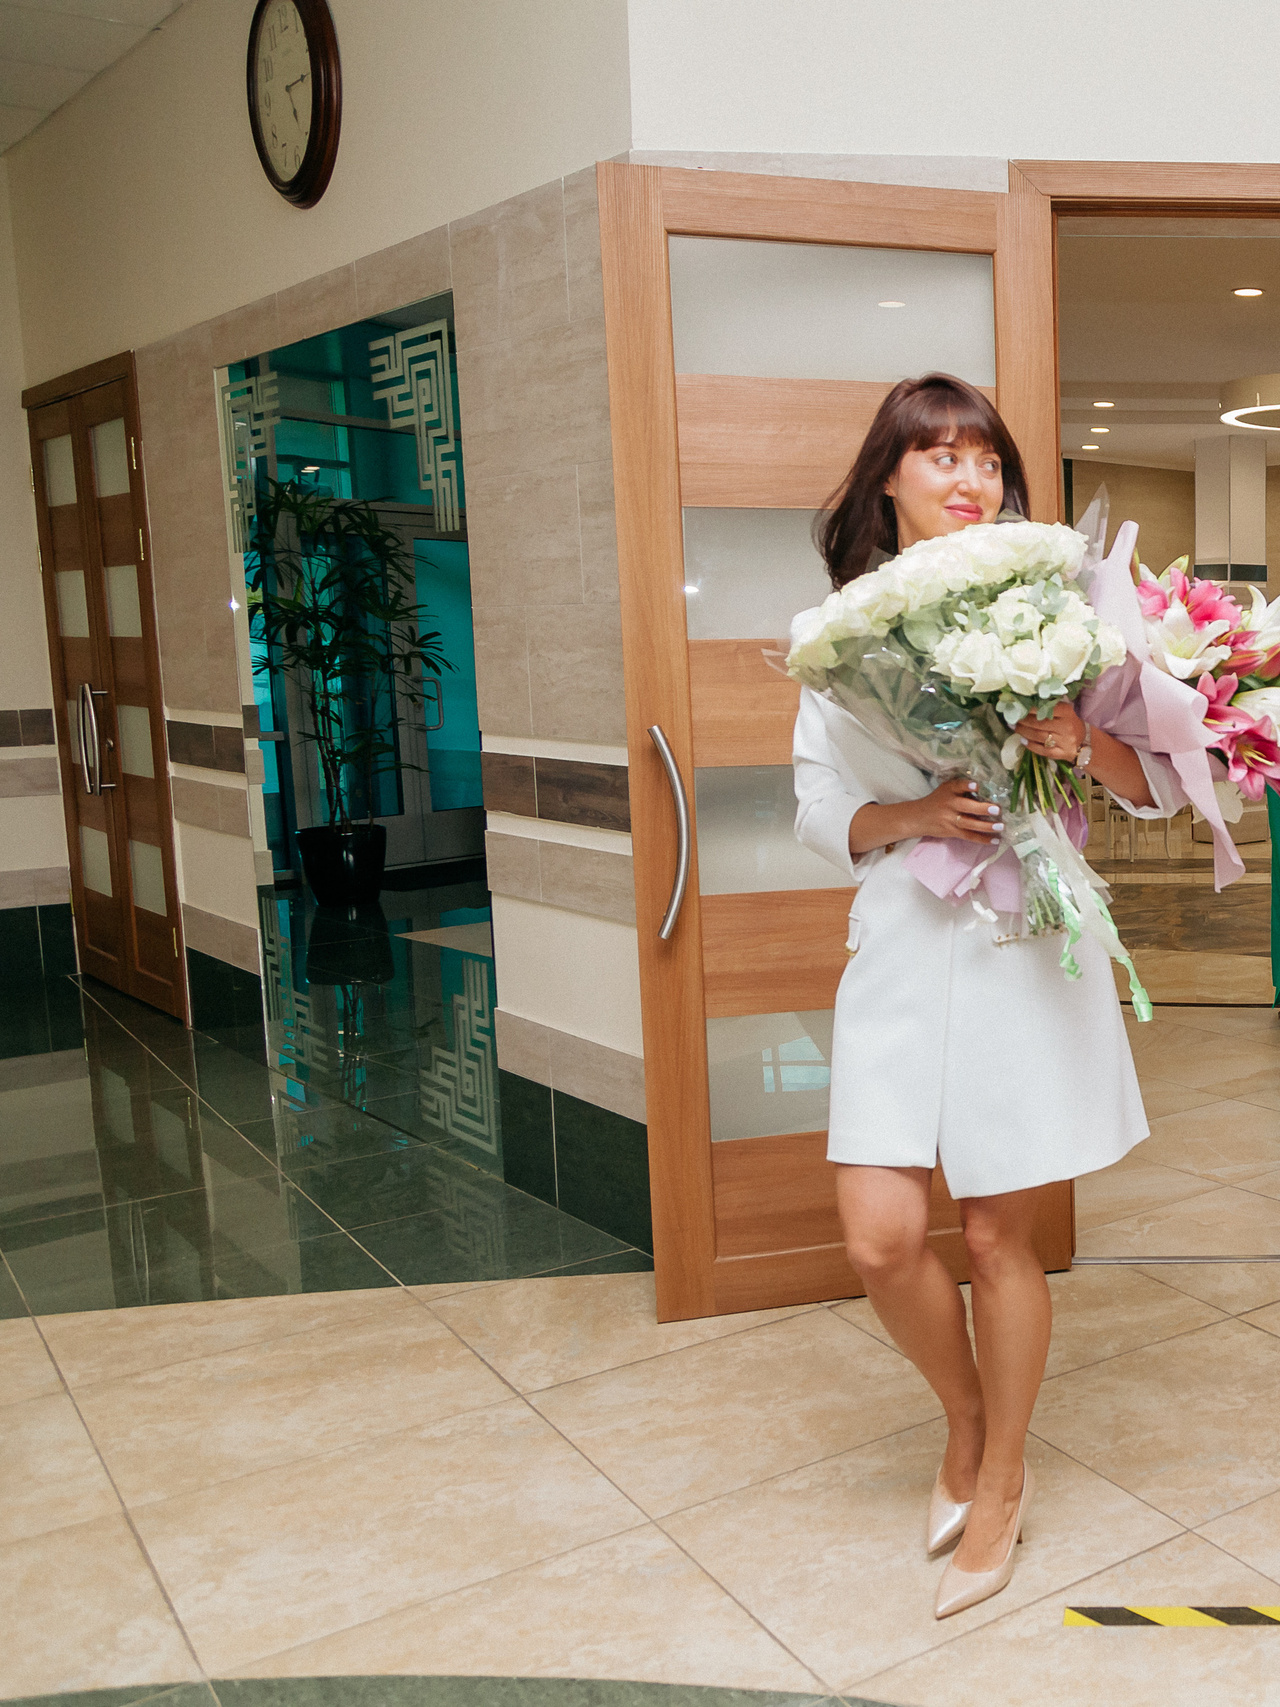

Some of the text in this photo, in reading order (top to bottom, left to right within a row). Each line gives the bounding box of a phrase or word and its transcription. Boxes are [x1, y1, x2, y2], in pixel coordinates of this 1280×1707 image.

[277, 4, 289, 33] 12
[293, 8, 299, 33] 1
[268, 24, 277, 51] 11
[263, 55, 273, 82] 10
[265, 92, 271, 117] 9
[271, 123, 278, 149] 8
[281, 142, 287, 168] 7
[294, 145, 301, 171] 6
